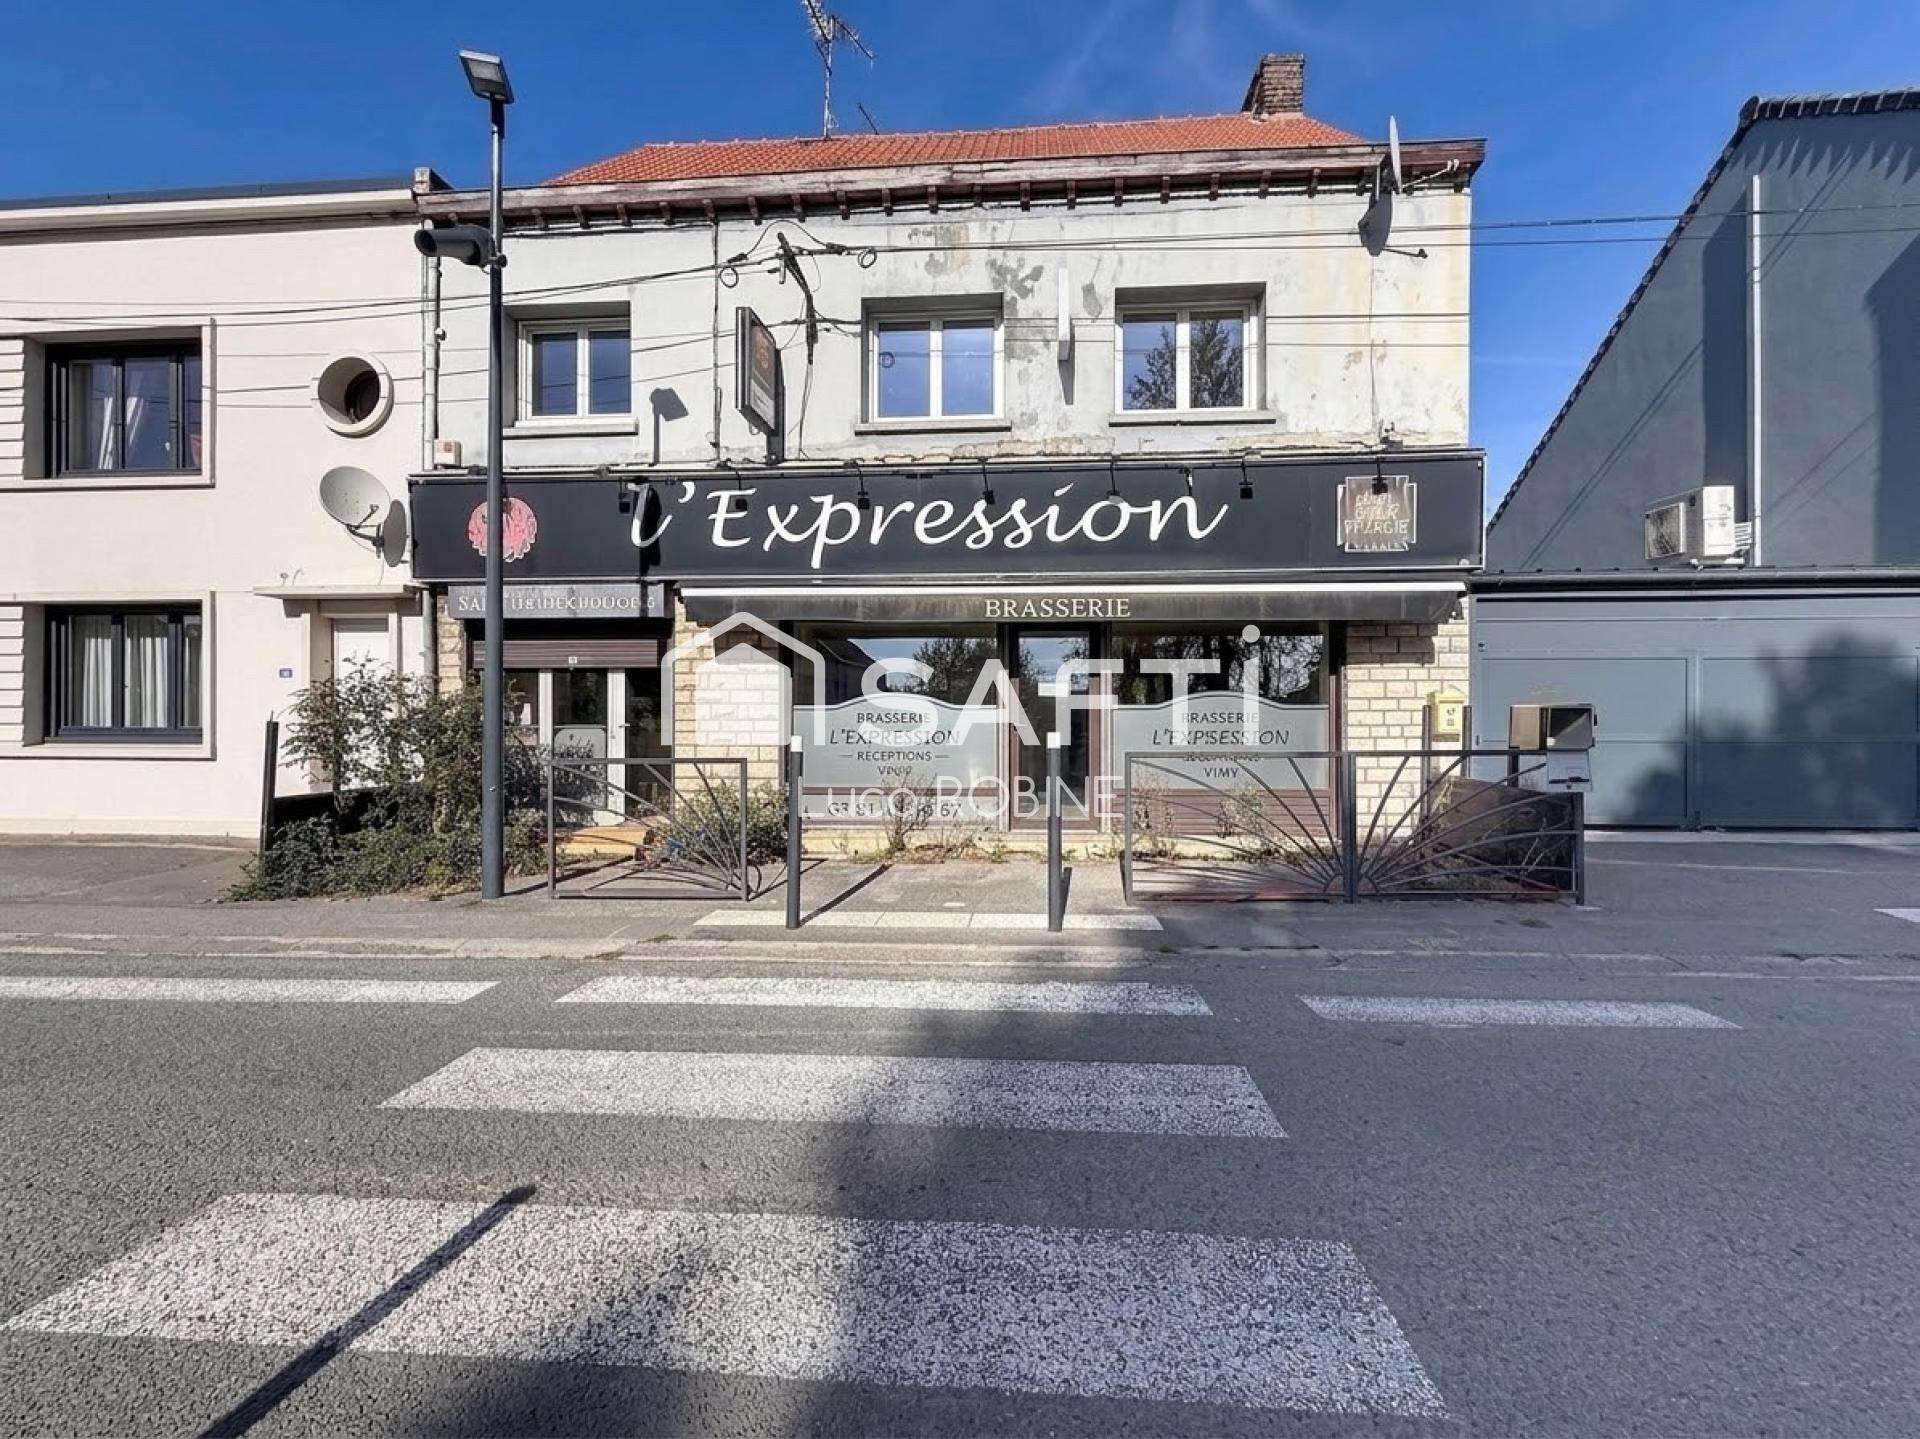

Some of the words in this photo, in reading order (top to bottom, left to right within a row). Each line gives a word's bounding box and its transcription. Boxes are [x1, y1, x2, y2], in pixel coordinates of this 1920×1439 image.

[984, 598, 1131, 619] BRASSERIE
[856, 712, 931, 724] BRASSERIE
[829, 728, 960, 746] L'EXPRESSION
[856, 751, 932, 762] RECEPTIONS
[1204, 767, 1240, 779] VIMY
